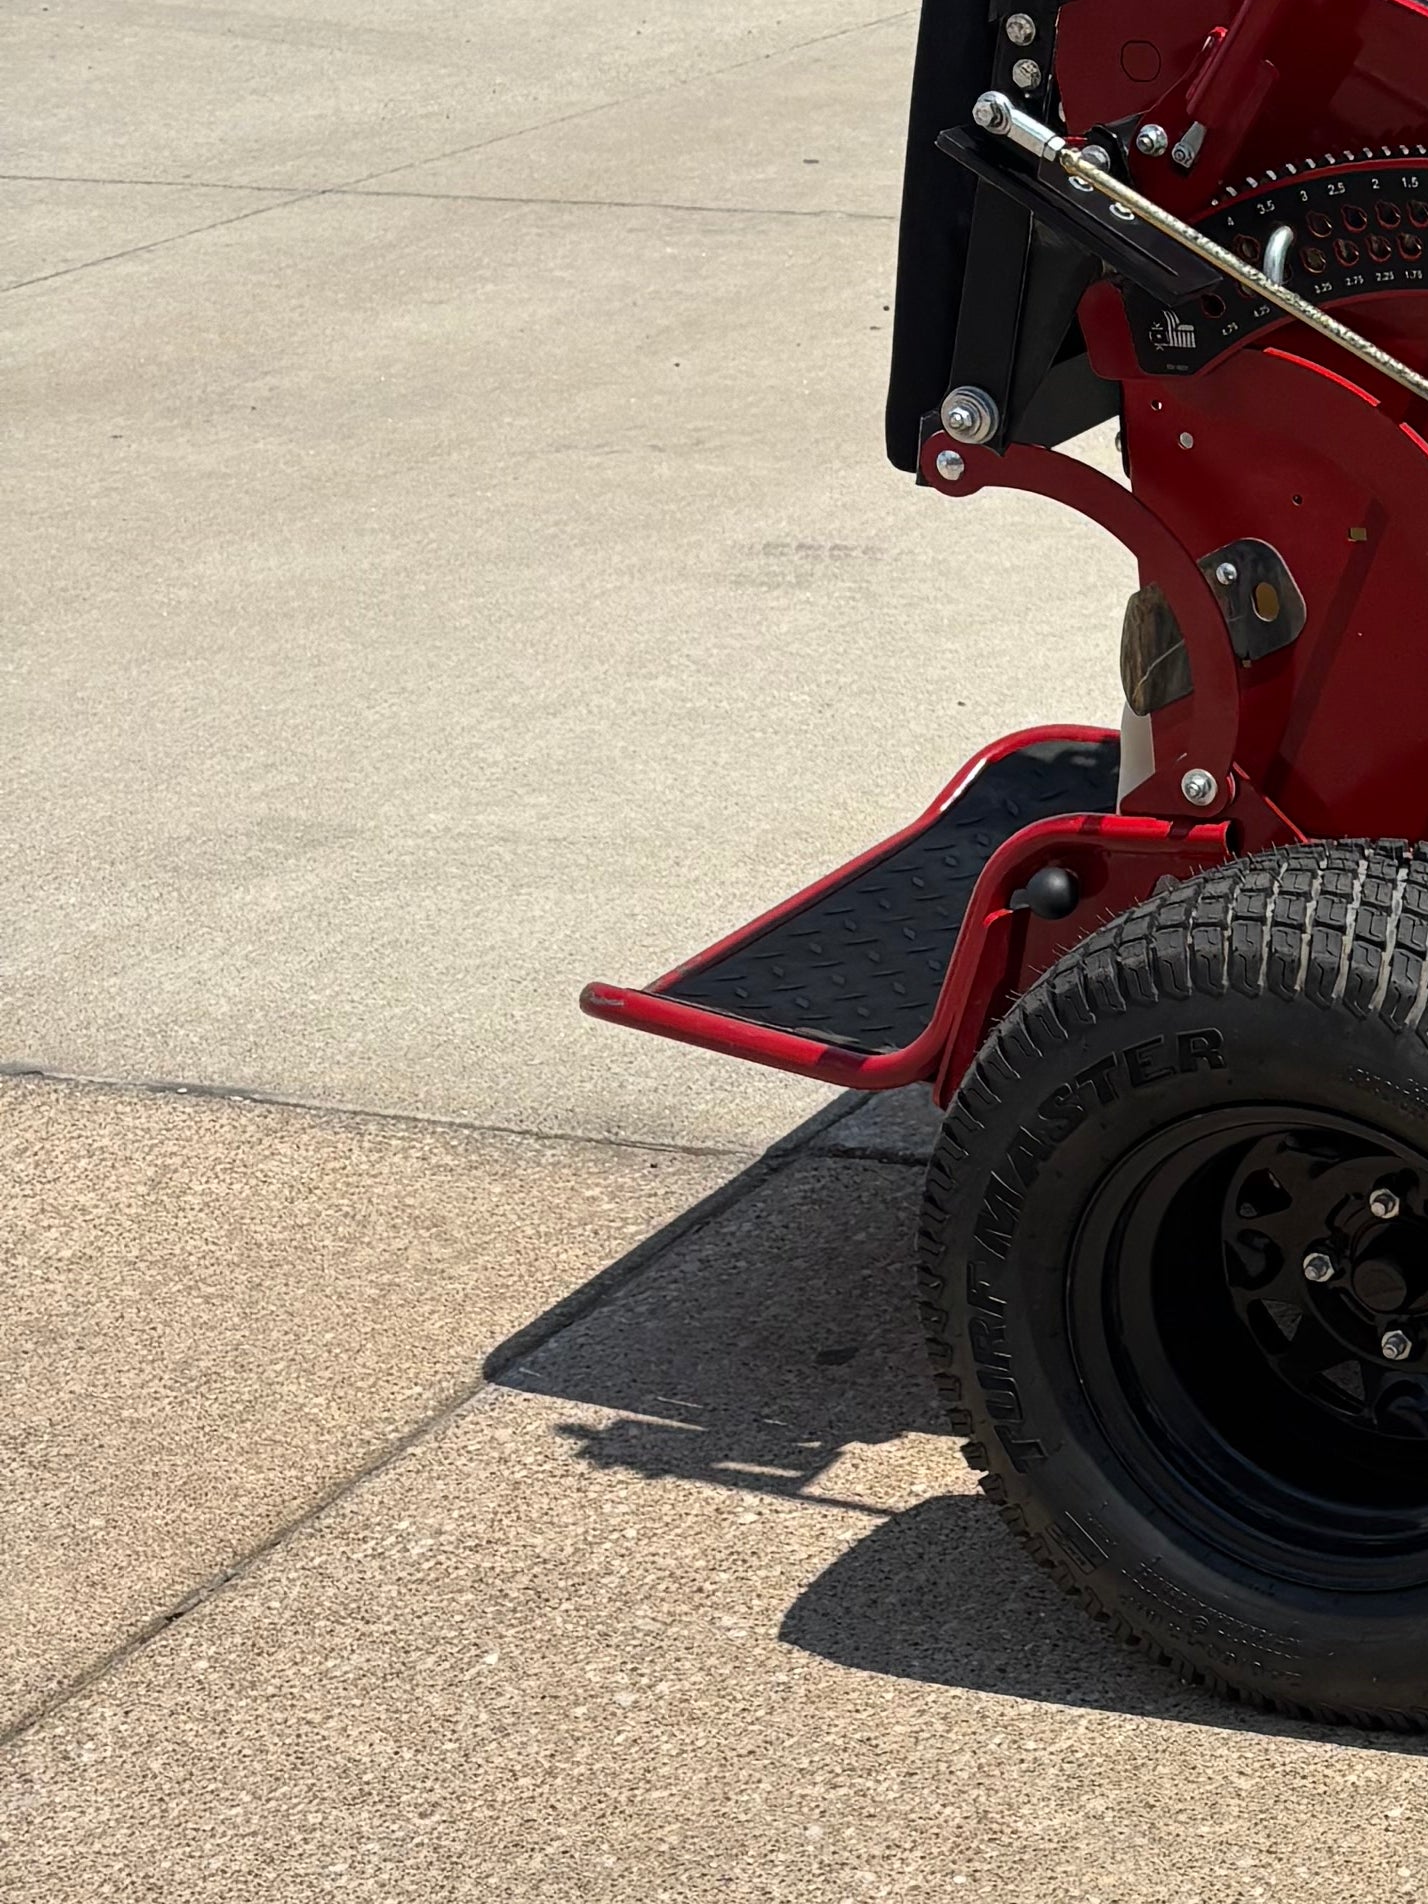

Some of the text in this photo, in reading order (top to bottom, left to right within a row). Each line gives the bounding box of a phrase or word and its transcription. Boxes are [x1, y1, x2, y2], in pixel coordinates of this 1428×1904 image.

[1227, 176, 1419, 226] 4 3.5 3 2.5 2 1.5
[1345, 273, 1364, 286] 2.75
[1375, 270, 1395, 282] 2.25
[1404, 269, 1423, 280] 1.75
